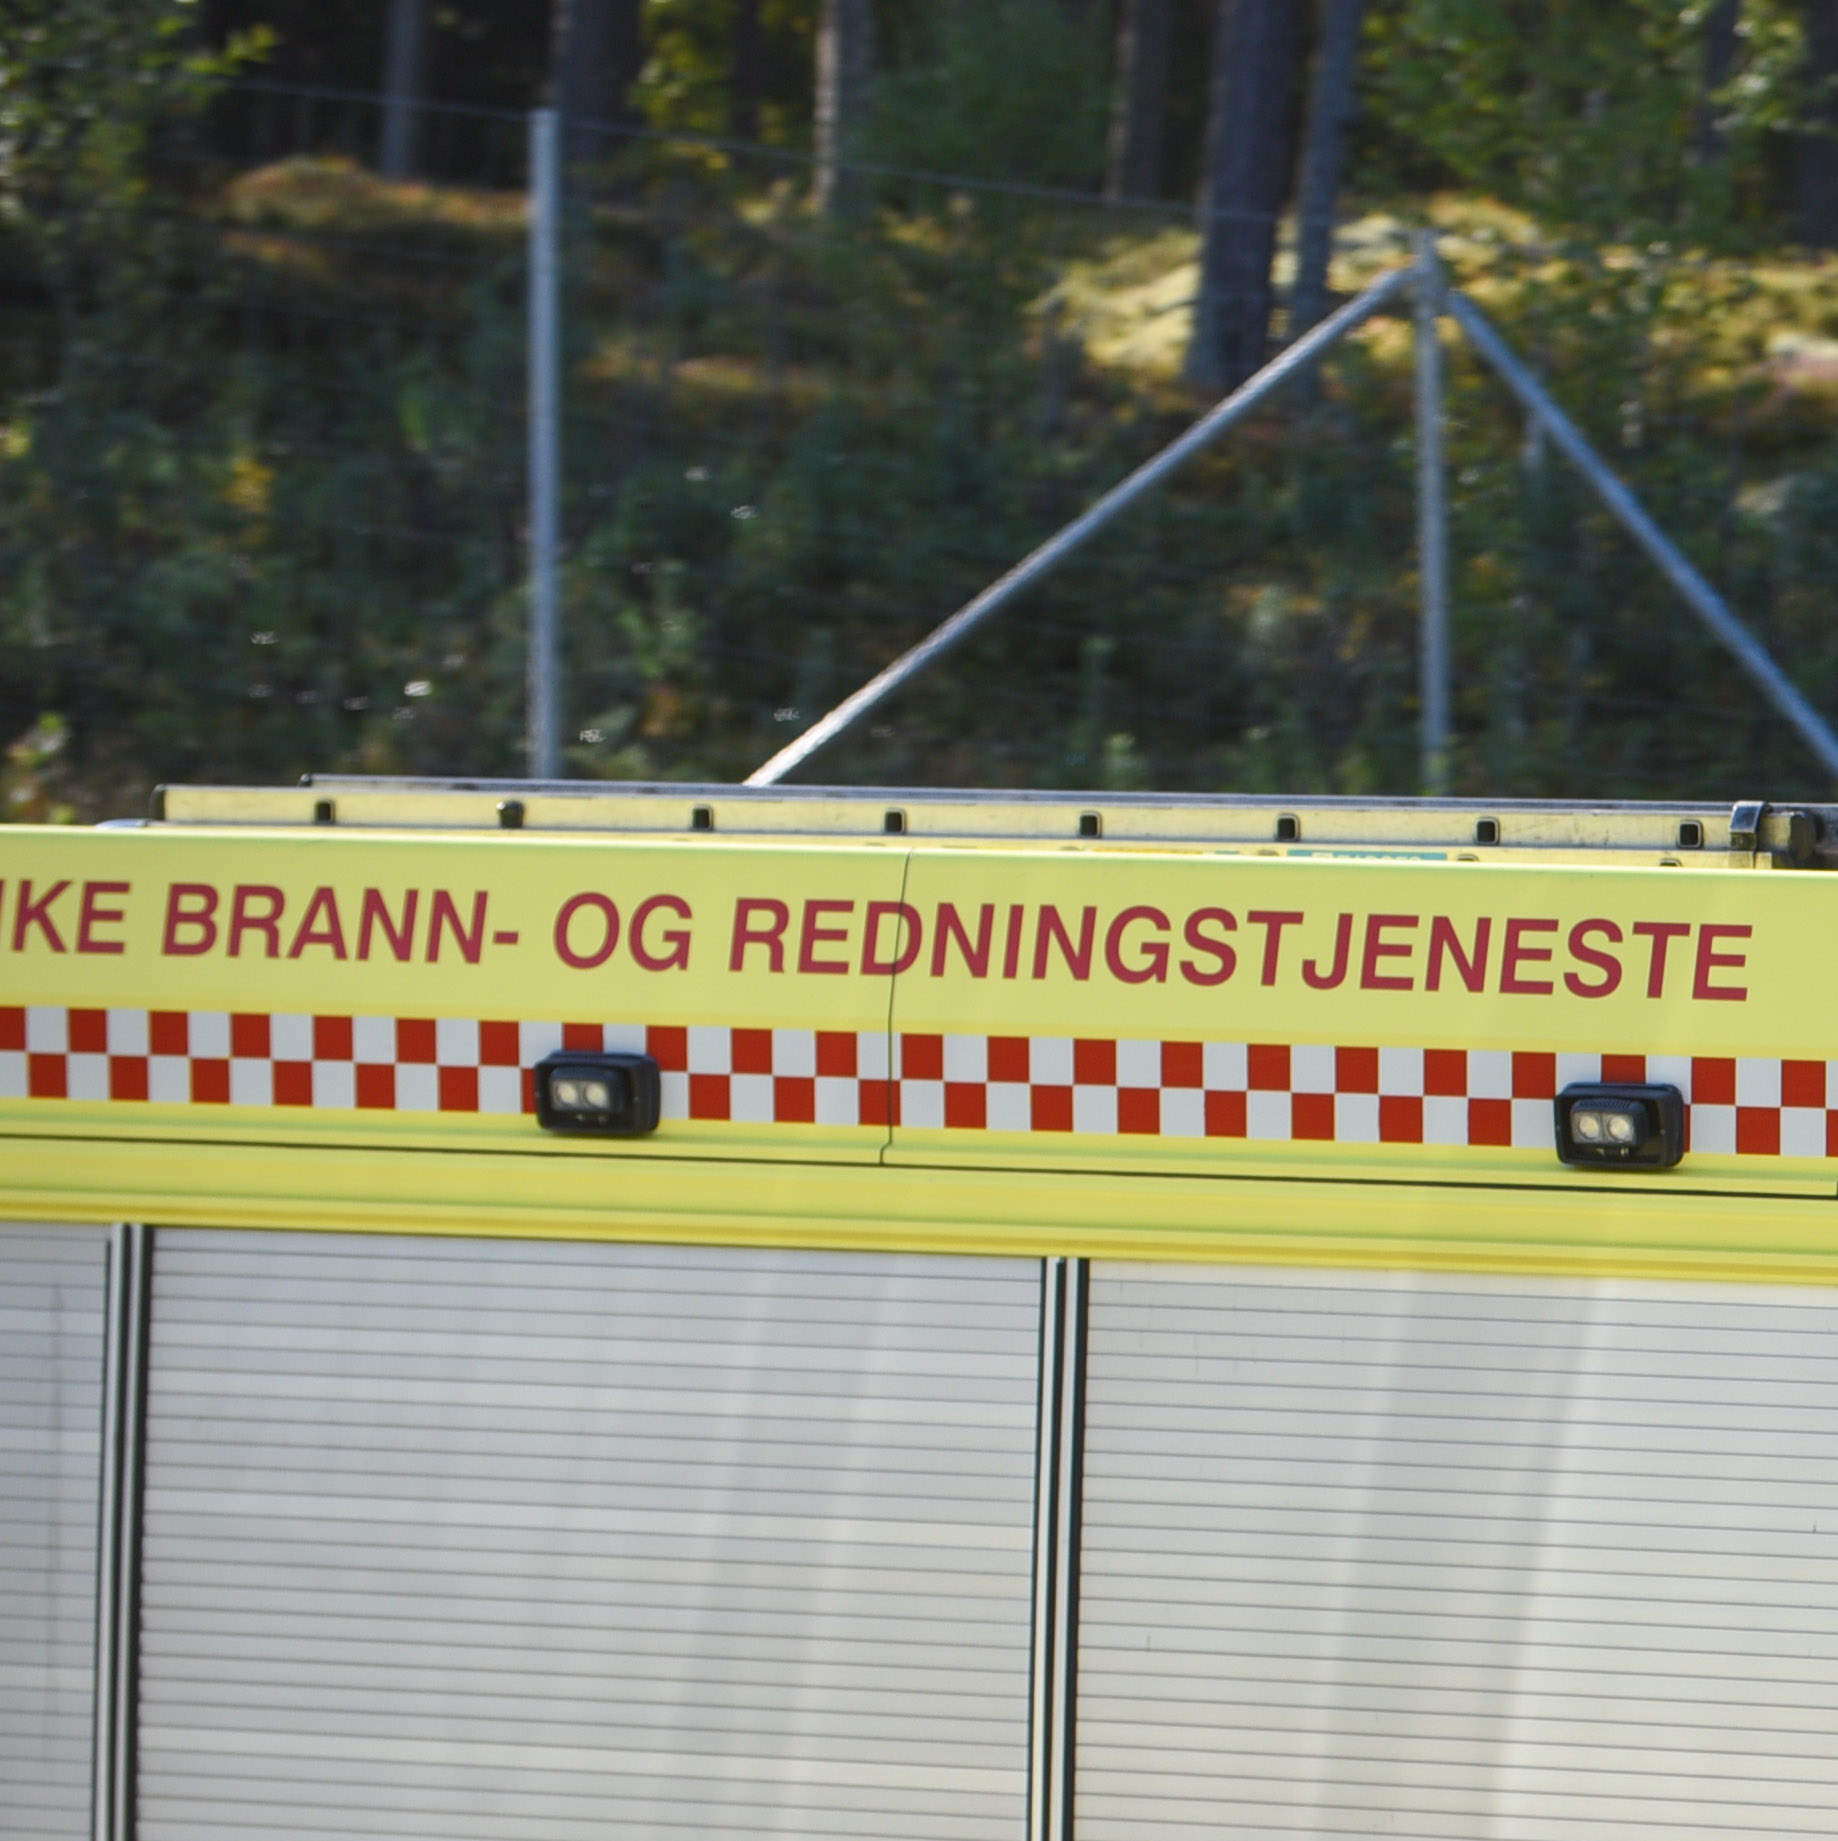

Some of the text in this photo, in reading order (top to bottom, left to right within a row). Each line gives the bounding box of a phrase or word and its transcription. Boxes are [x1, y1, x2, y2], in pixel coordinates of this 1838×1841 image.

[162, 882, 520, 965] BRANN-
[554, 892, 693, 972] OG
[729, 897, 1753, 1002] REDNINGSTJENESTE
